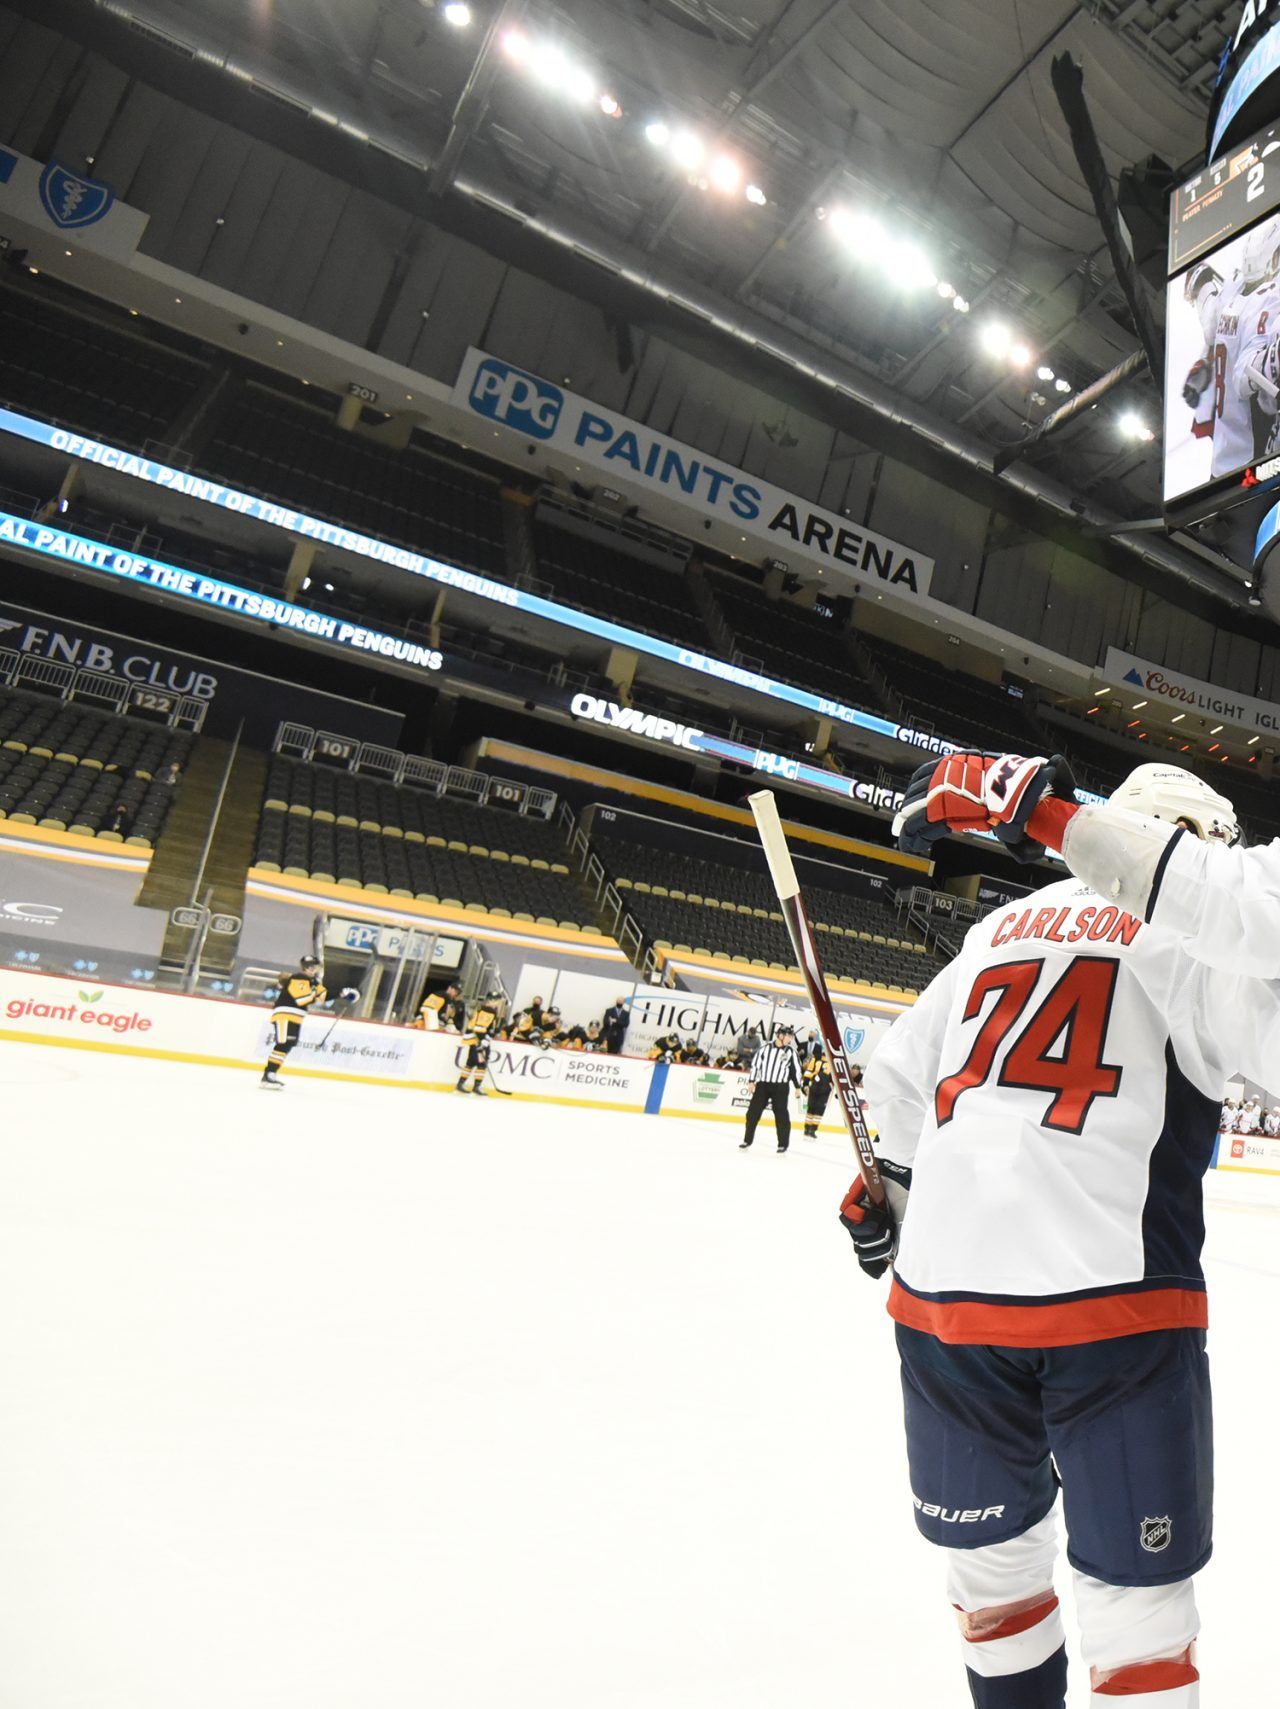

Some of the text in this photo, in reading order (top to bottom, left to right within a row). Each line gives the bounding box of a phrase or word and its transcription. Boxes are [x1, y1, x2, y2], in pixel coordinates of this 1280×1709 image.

[1246, 162, 1265, 203] 2
[351, 384, 377, 402] 201
[473, 368, 919, 593] PPG PAINTS ARENA
[50, 431, 521, 607] OFFICIAL PAINT OF THE PITTSBURGH PENGUINS
[33, 529, 115, 567] PAINT
[113, 552, 149, 578] OF
[149, 561, 196, 594] THE
[197, 578, 337, 639] PITTSBURGH
[337, 623, 444, 671] PENGUINS
[21, 625, 219, 700] F.N.B. CLUB
[134, 691, 172, 713] 122
[1145, 669, 1197, 705] Coors
[1198, 696, 1246, 721] LIGHT
[570, 692, 706, 752] OLYMPIC
[320, 737, 350, 759] 101
[495, 784, 520, 803] 101
[601, 809, 617, 821] 102
[869, 878, 883, 889] 102
[934, 897, 953, 911] 103
[990, 905, 1143, 948] CARLSON
[5, 998, 153, 1033] giant eagle
[641, 1001, 806, 1048] HIGHMARK
[934, 955, 1125, 1136] 74
[564, 1073, 631, 1089] MEDICINE
[567, 1059, 621, 1076] SPORTS
